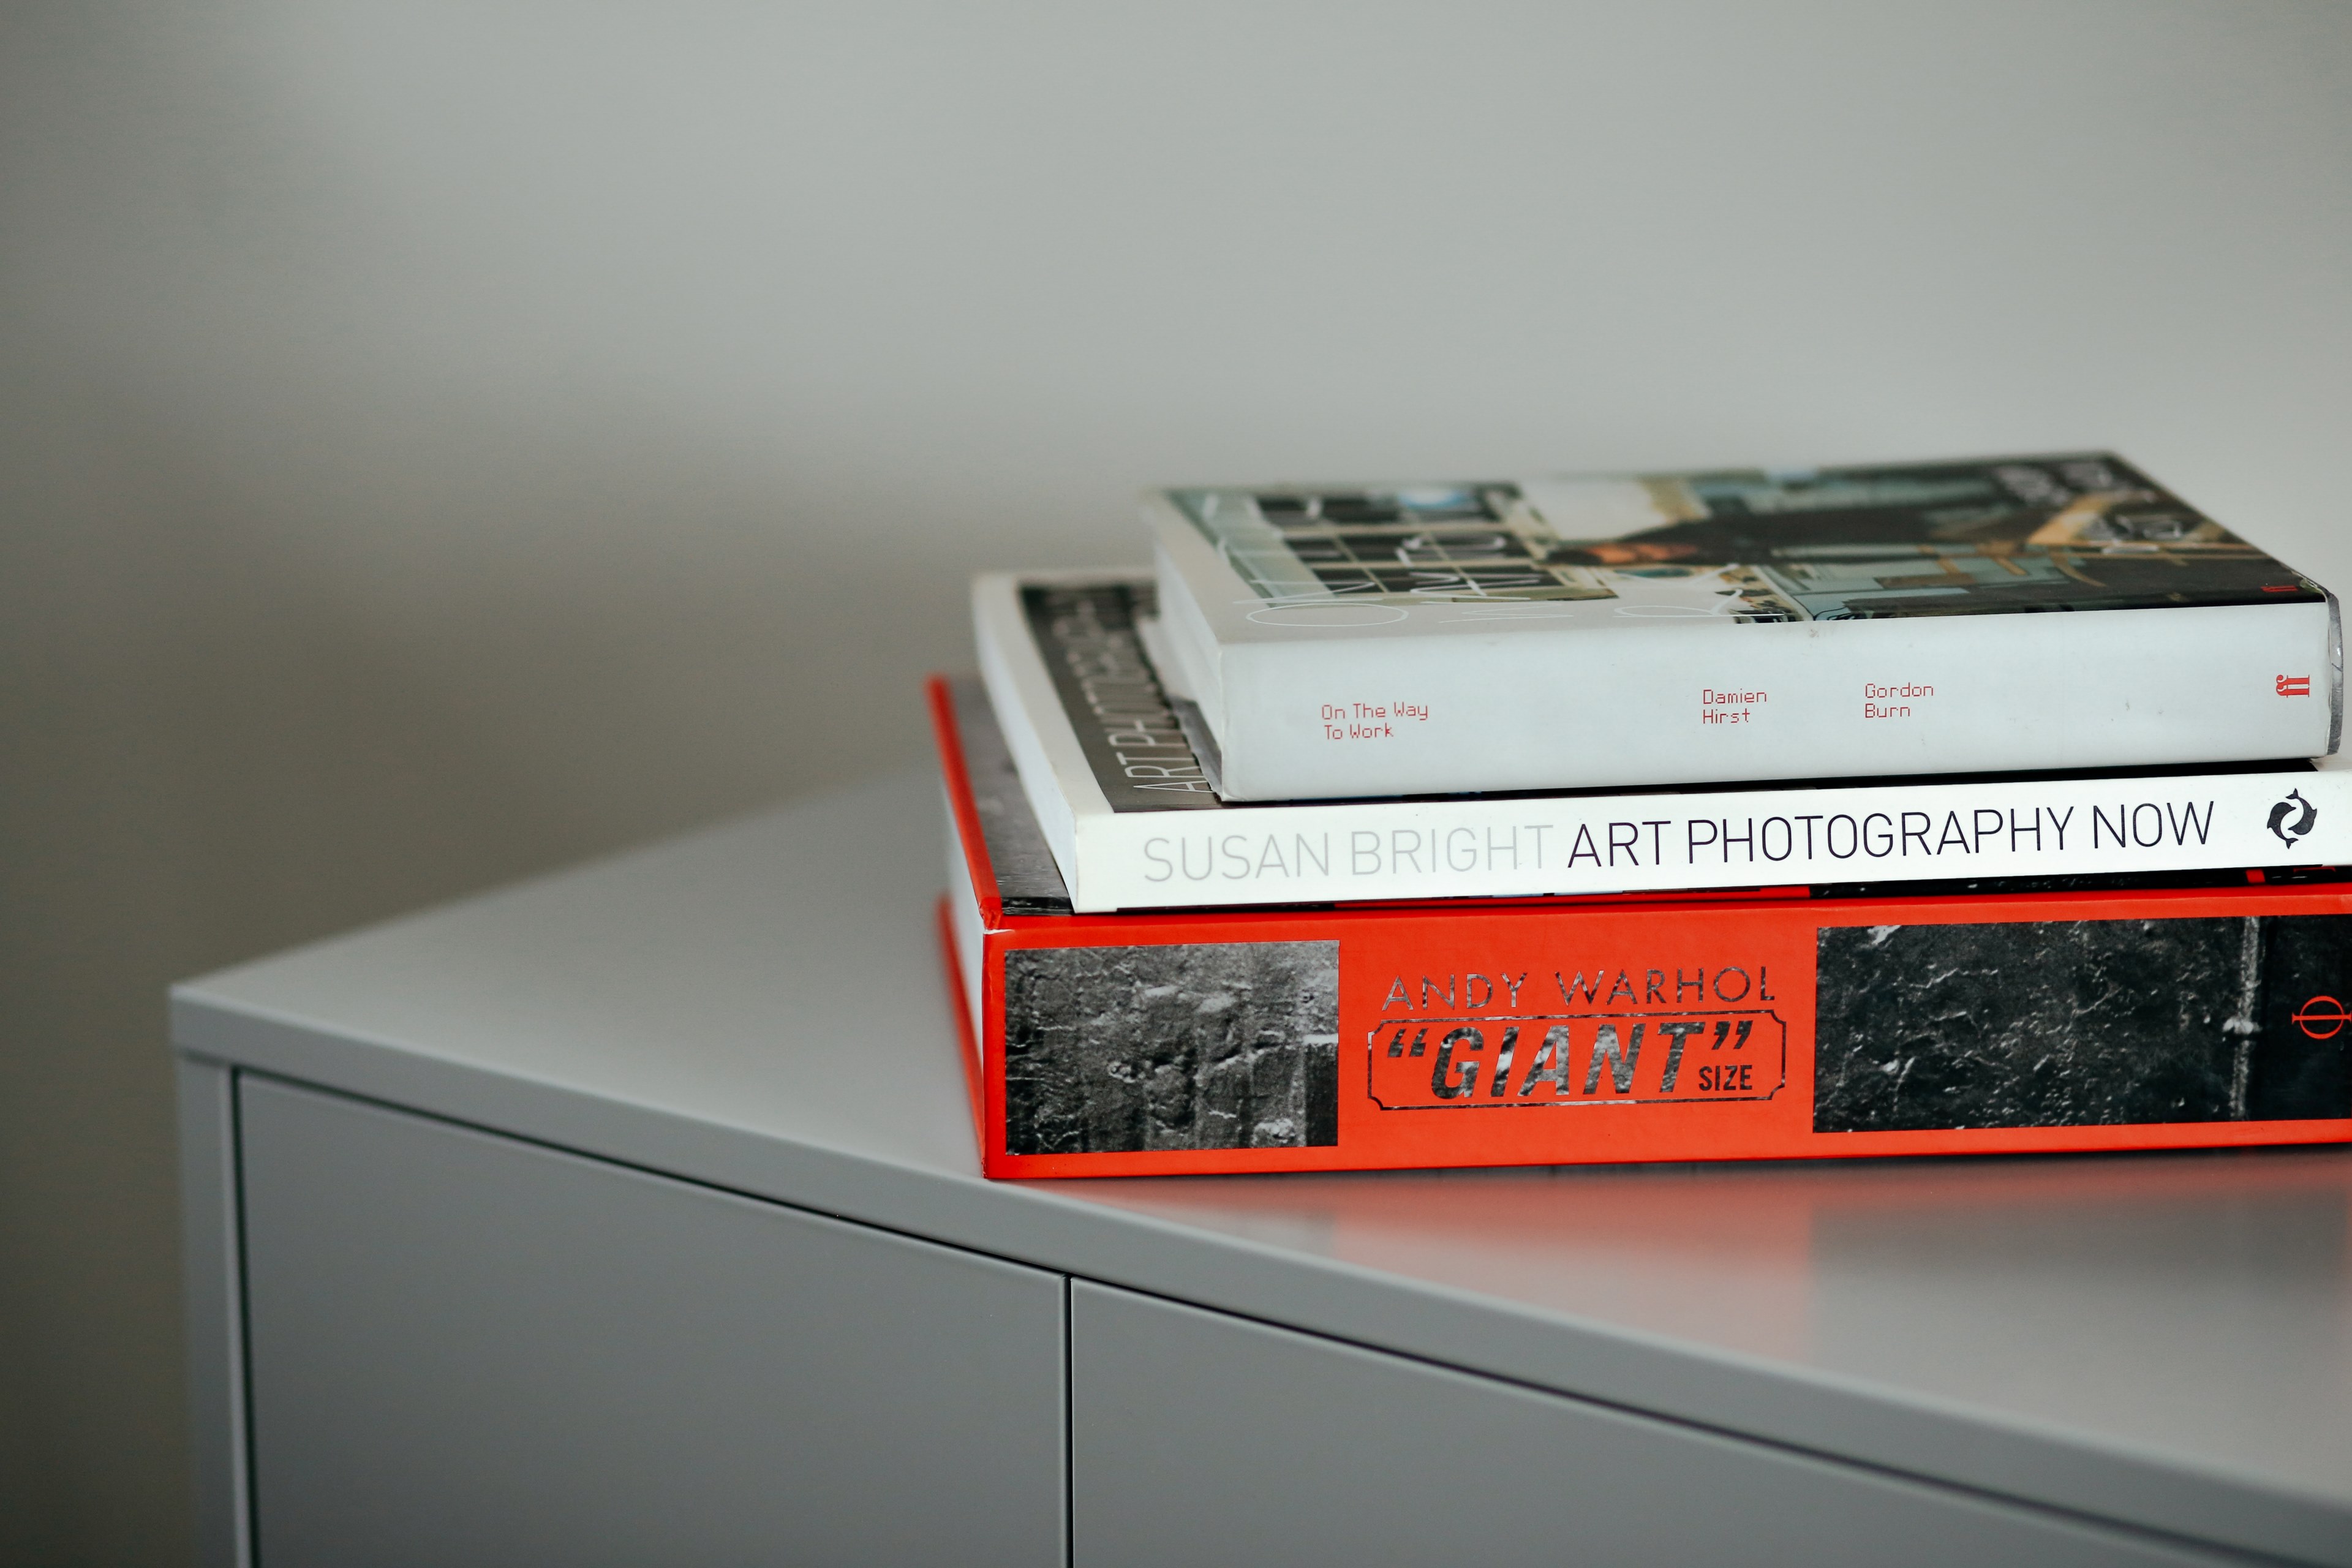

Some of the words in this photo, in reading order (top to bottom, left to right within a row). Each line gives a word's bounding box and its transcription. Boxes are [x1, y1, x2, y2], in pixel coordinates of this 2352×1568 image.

[1703, 688, 1767, 704] Damien
[1865, 682, 1934, 699] Gordon
[1321, 704, 1346, 720] On
[1352, 703, 1386, 718] The
[1393, 702, 1429, 721] Way
[1702, 707, 1750, 724] Hirst
[1864, 703, 1911, 718] Burn
[1324, 724, 1343, 740] To
[1349, 722, 1393, 739] Work
[1116, 752, 1215, 793] ART
[1144, 833, 1329, 882] SUSAN
[1352, 825, 1554, 875] BRIGHT
[1567, 821, 1672, 869] ART
[1688, 806, 2075, 864] PHOTOGRAPHY
[2093, 800, 2215, 850] NOW
[1382, 972, 1528, 1011] ANDY
[1555, 966, 1775, 1006] WARHOL
[1698, 1065, 1752, 1091] SIZE
